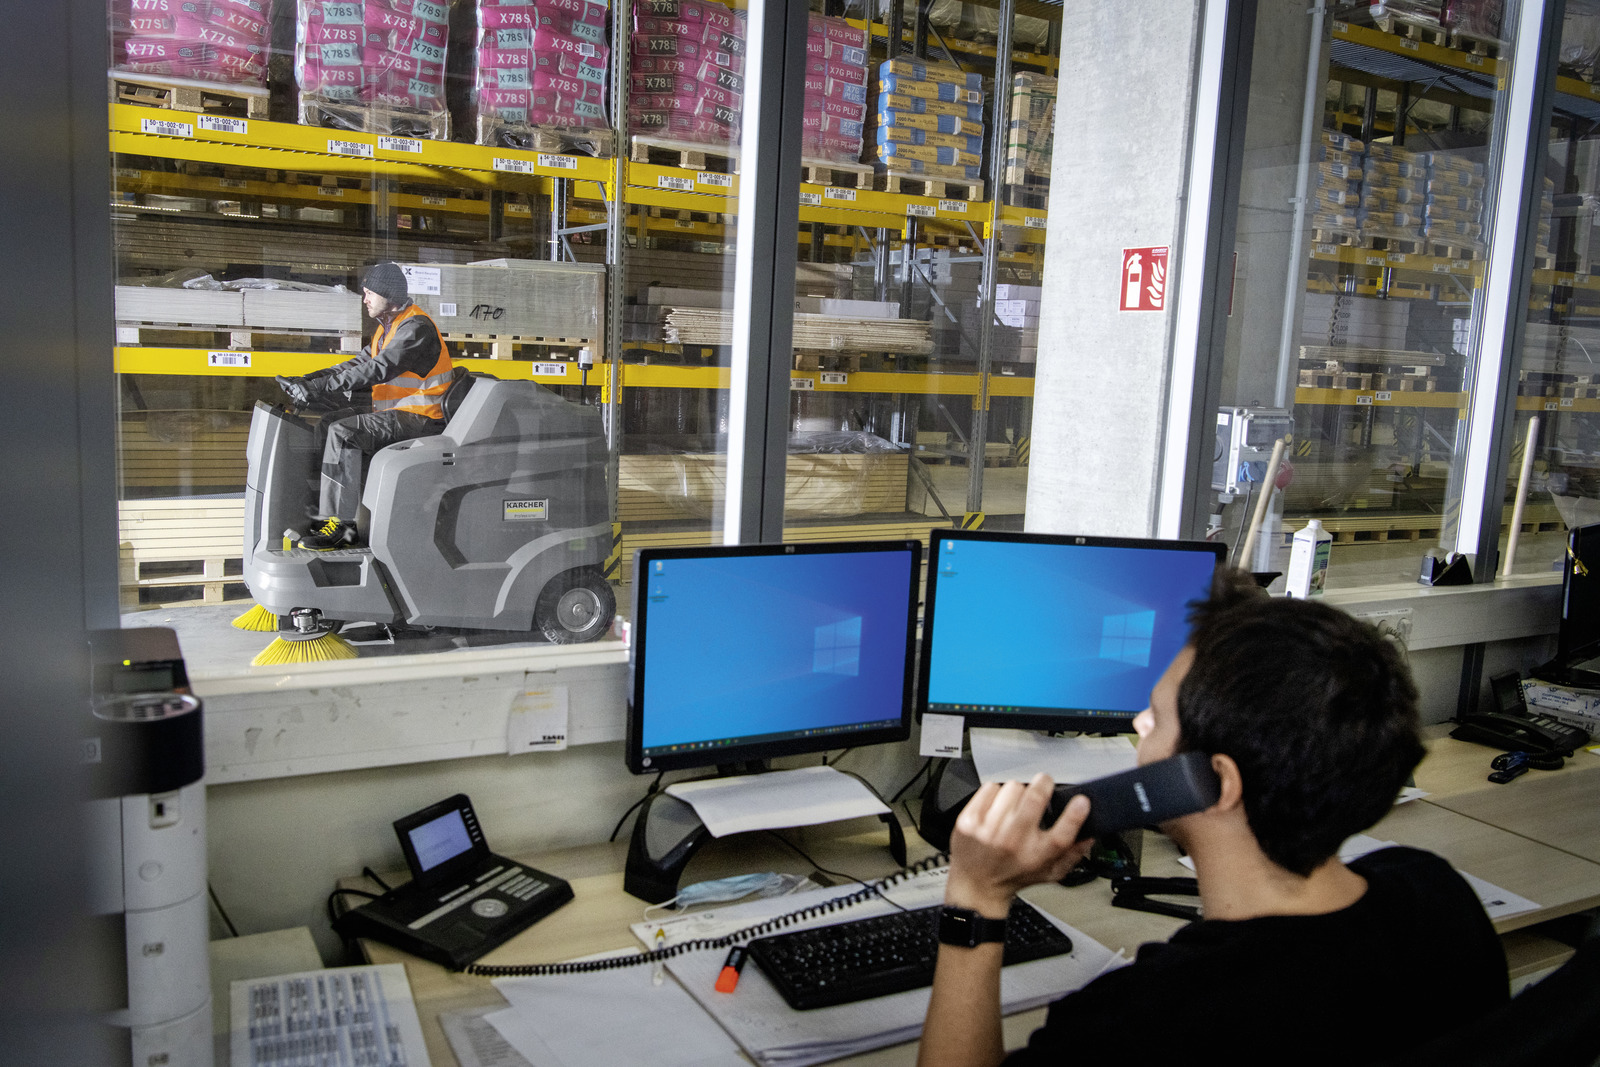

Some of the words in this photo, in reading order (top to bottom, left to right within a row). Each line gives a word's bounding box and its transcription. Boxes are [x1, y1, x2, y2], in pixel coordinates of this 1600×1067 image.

[844, 32, 861, 42] PLUS
[845, 70, 862, 80] PLUS
[150, 119, 185, 129] 50-13-002-01
[206, 117, 239, 127] 54-13-002-03
[469, 304, 504, 321] 170
